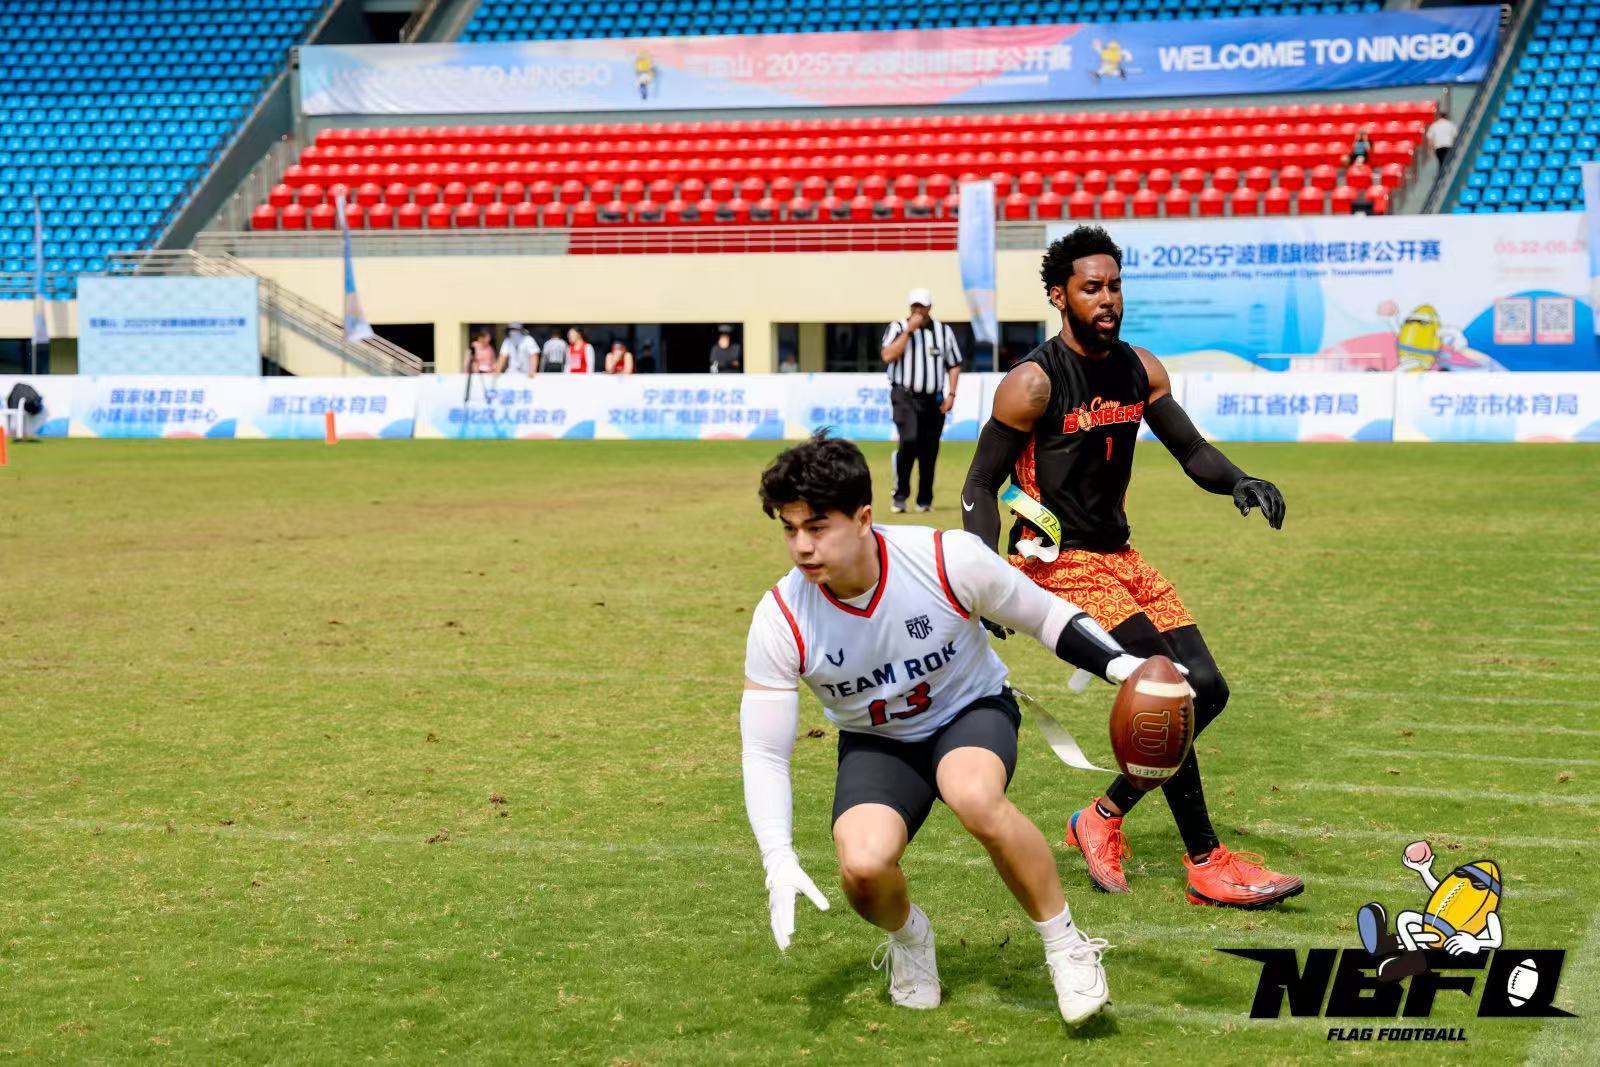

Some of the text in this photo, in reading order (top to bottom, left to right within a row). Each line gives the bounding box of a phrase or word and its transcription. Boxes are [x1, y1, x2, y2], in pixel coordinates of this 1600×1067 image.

[1158, 31, 1475, 72] WELCOME TO NINGBO
[267, 395, 388, 415] 浙江省体育局
[1216, 393, 1359, 416] 浙江省体育局
[1429, 393, 1579, 416] 宁波市体育局
[1105, 437, 1113, 461] 1
[819, 640, 957, 697] TEAM ROK
[868, 681, 932, 726] 13
